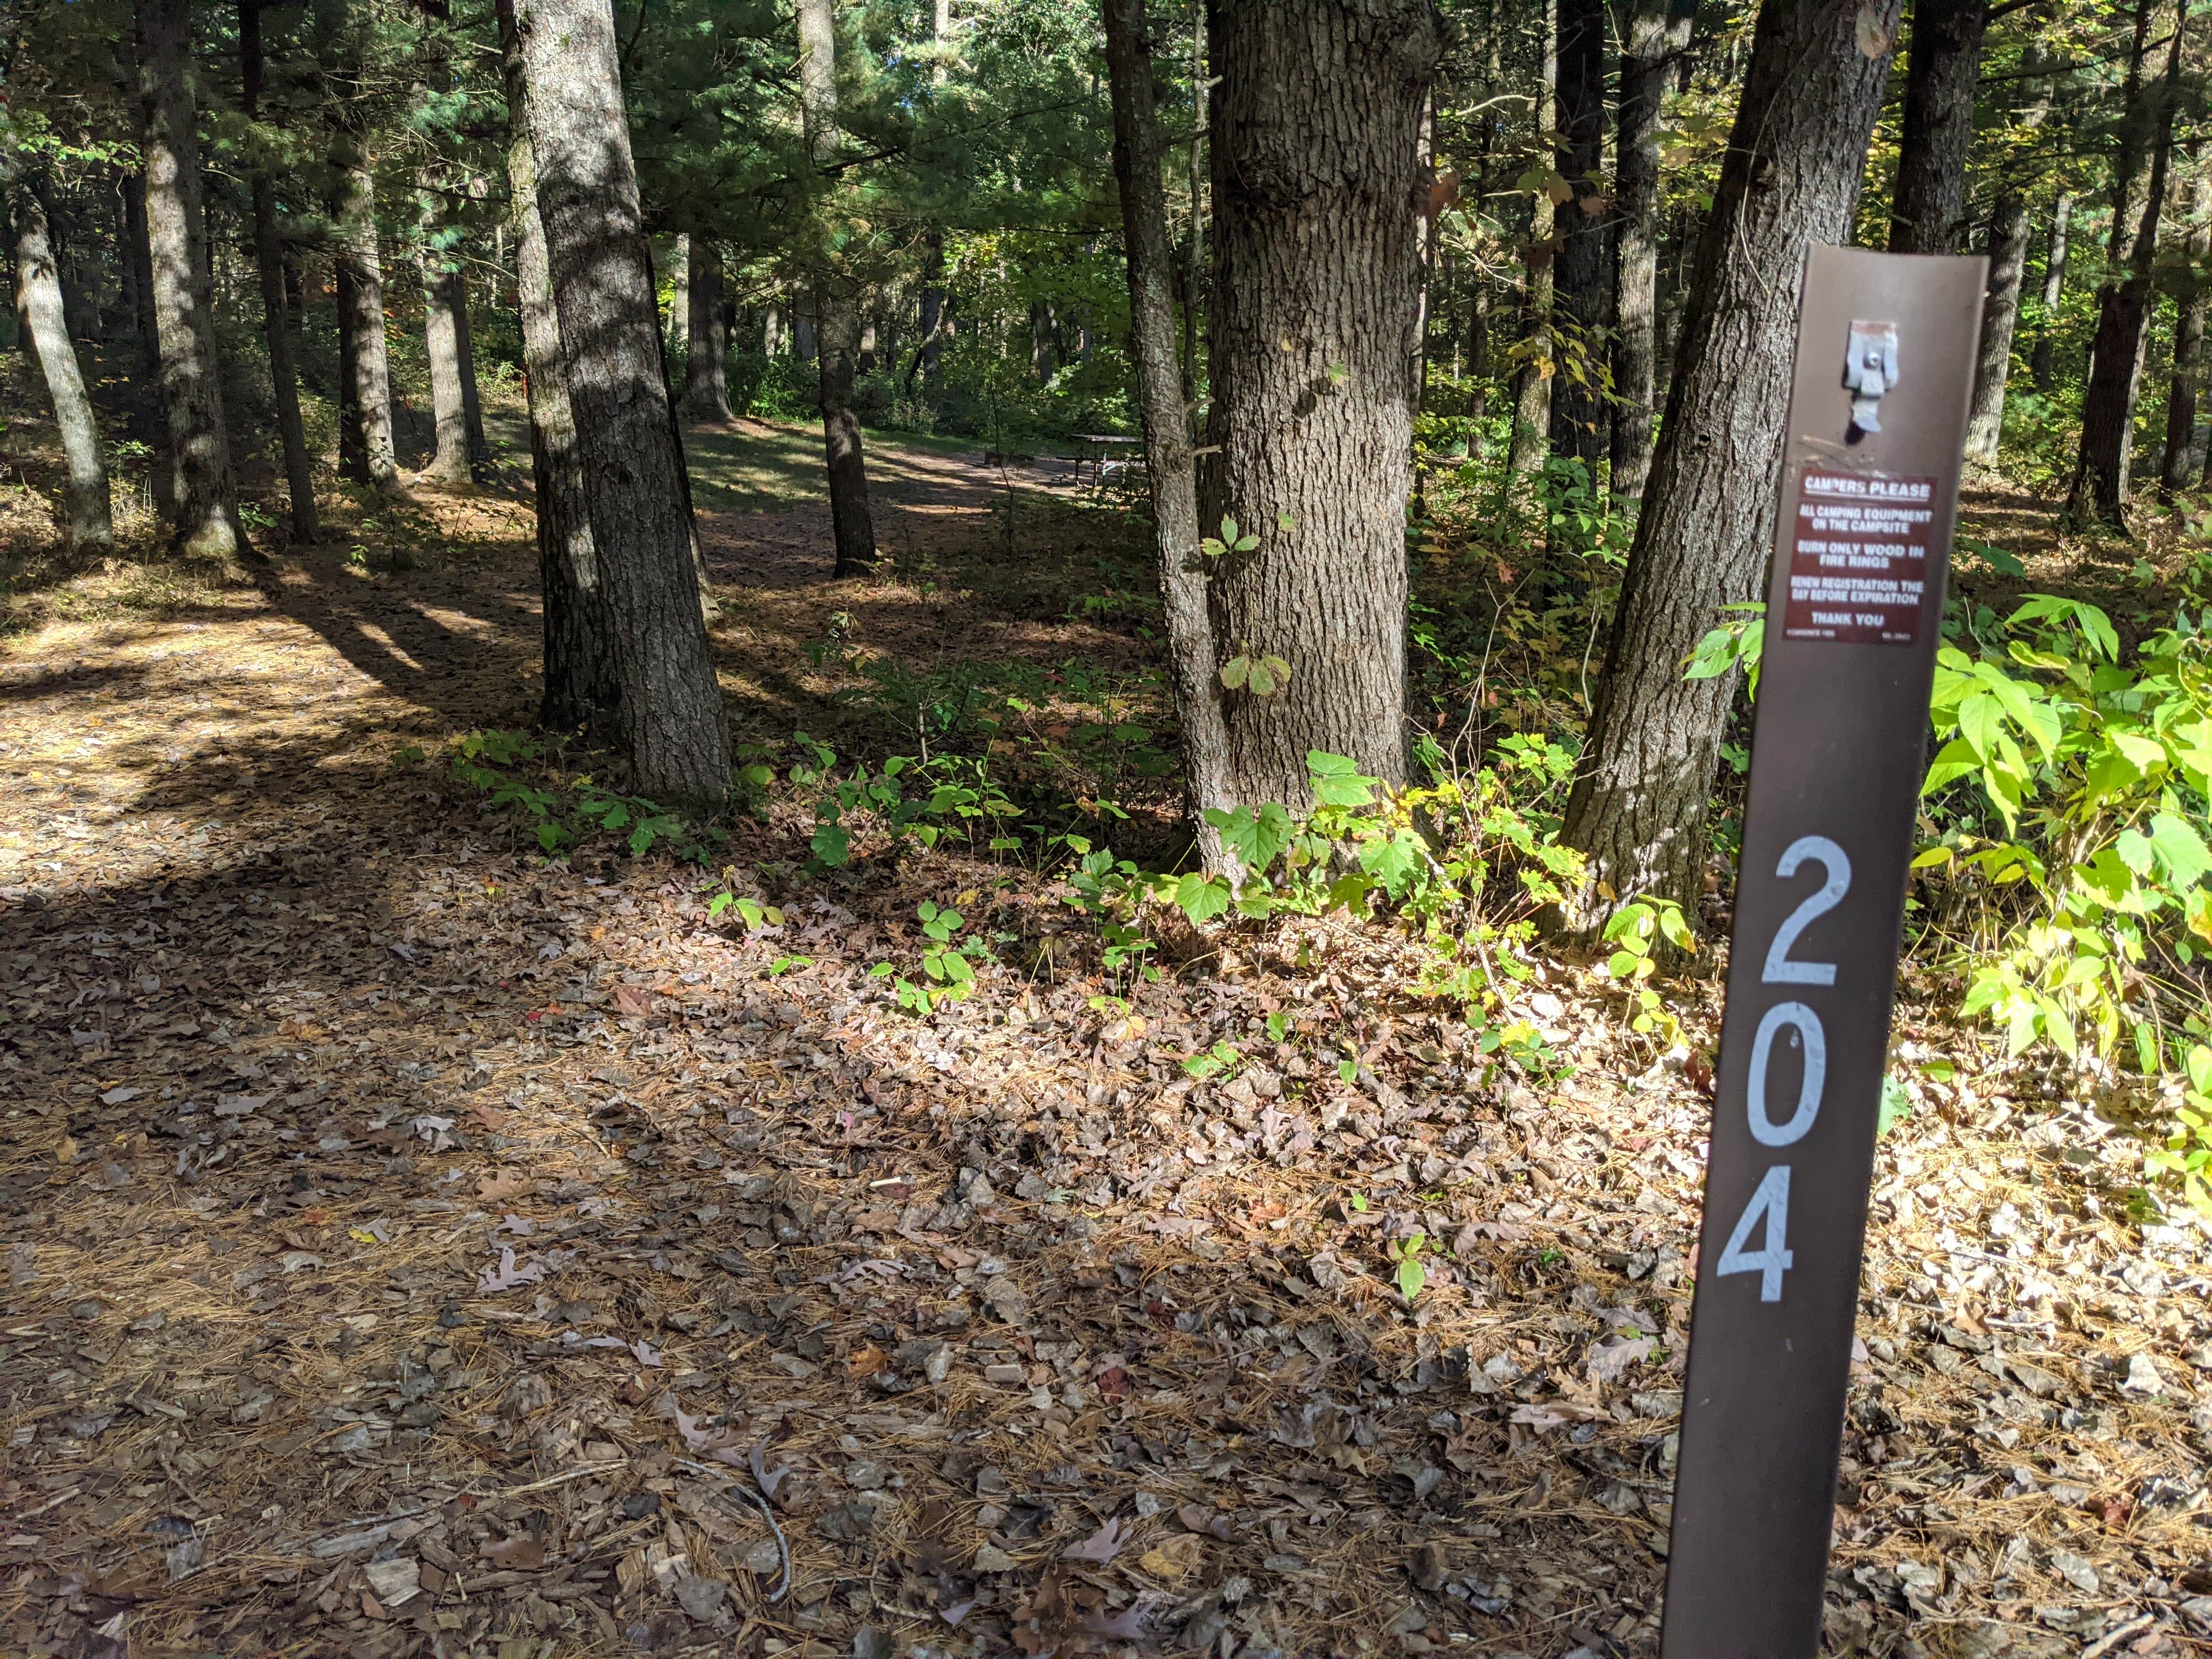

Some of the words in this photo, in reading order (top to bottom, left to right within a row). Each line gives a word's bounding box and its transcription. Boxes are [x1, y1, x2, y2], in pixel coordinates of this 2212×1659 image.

[1805, 476, 1866, 494] CAMPERS
[1869, 481, 1931, 498] PLEASE
[1799, 504, 1815, 517] ALL
[1816, 505, 1861, 520] CAMPING
[1864, 507, 1933, 522] EQUIPMENT
[1812, 519, 1826, 531] ON
[1829, 520, 1848, 531] THE
[1850, 521, 1910, 535] CAMPSITE
[1797, 540, 1827, 553] BURN
[1829, 541, 1860, 555] ONLY
[1864, 543, 1905, 557] WOOD
[1909, 545, 1925, 557] IN
[1819, 554, 1846, 567] FIRE
[1848, 556, 1890, 568] RINGS
[1791, 575, 1819, 589] RENEW
[1821, 577, 1898, 591] REGISTRATION
[1901, 580, 1924, 593] THE
[1792, 588, 1809, 600] DAY
[1810, 589, 1848, 602] BEFORE
[1850, 591, 1918, 605] EXPIRATION
[1812, 612, 1852, 625] THANK
[1855, 613, 1884, 627] YOU
[1716, 835, 1852, 1302] 204
